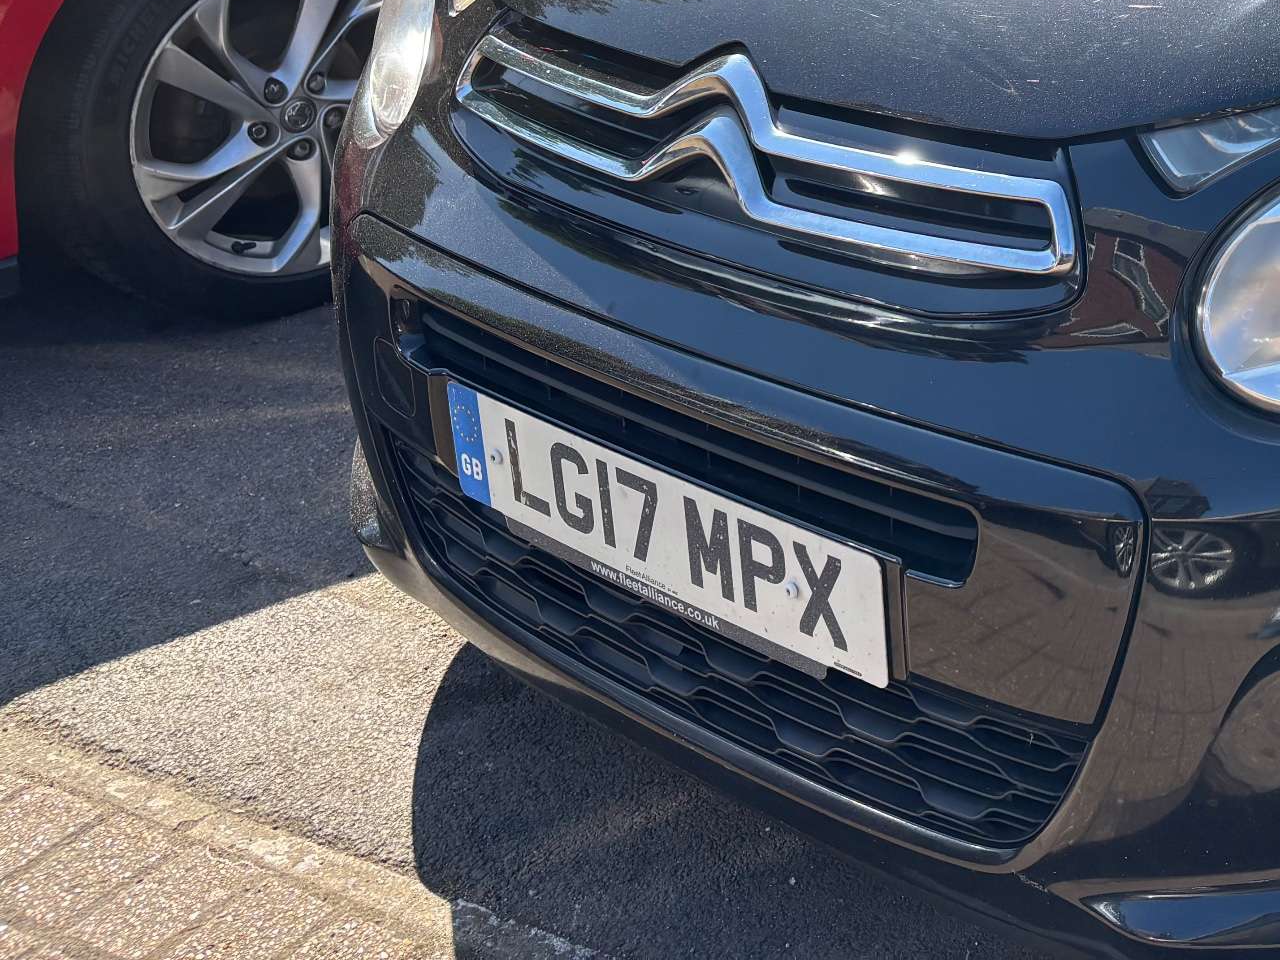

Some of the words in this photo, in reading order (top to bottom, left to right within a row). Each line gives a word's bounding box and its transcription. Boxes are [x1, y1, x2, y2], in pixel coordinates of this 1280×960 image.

[460, 452, 483, 481] GB
[504, 417, 659, 563] LG17
[682, 495, 848, 653] MPX
[590, 560, 720, 630] www.fleetalliance.co.uk
